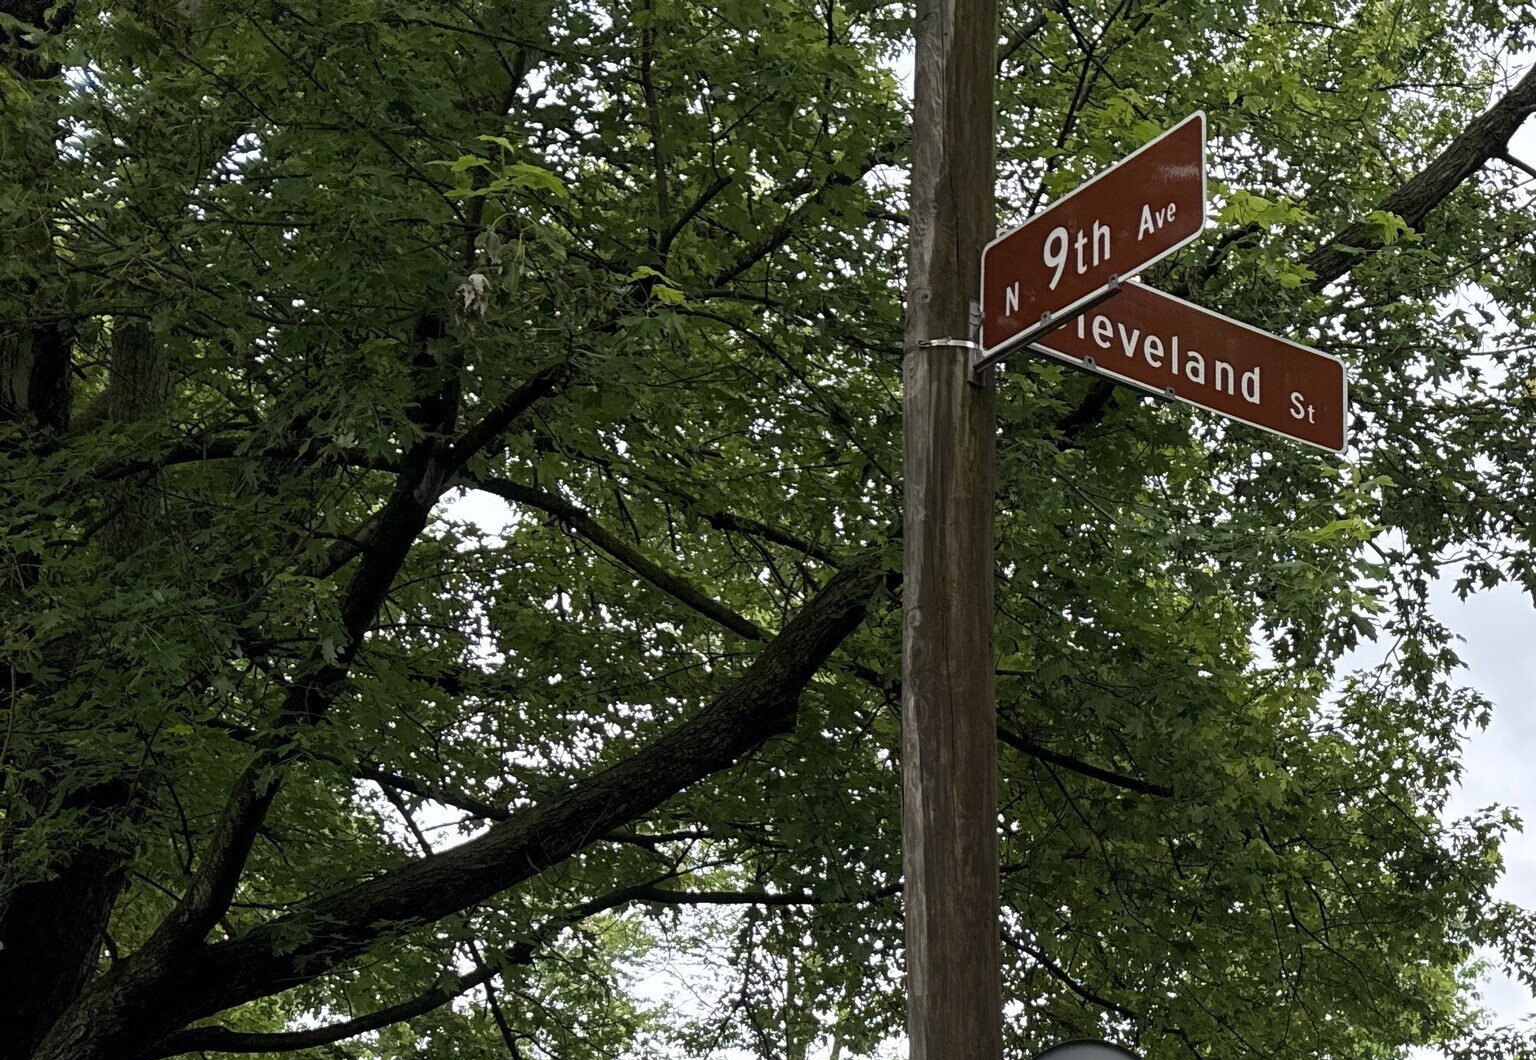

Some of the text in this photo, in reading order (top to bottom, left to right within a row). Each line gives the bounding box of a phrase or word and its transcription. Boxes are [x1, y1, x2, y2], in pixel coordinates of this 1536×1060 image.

[1005, 202, 1177, 316] N 9th Ave
[1057, 312, 1315, 424] leveland St
